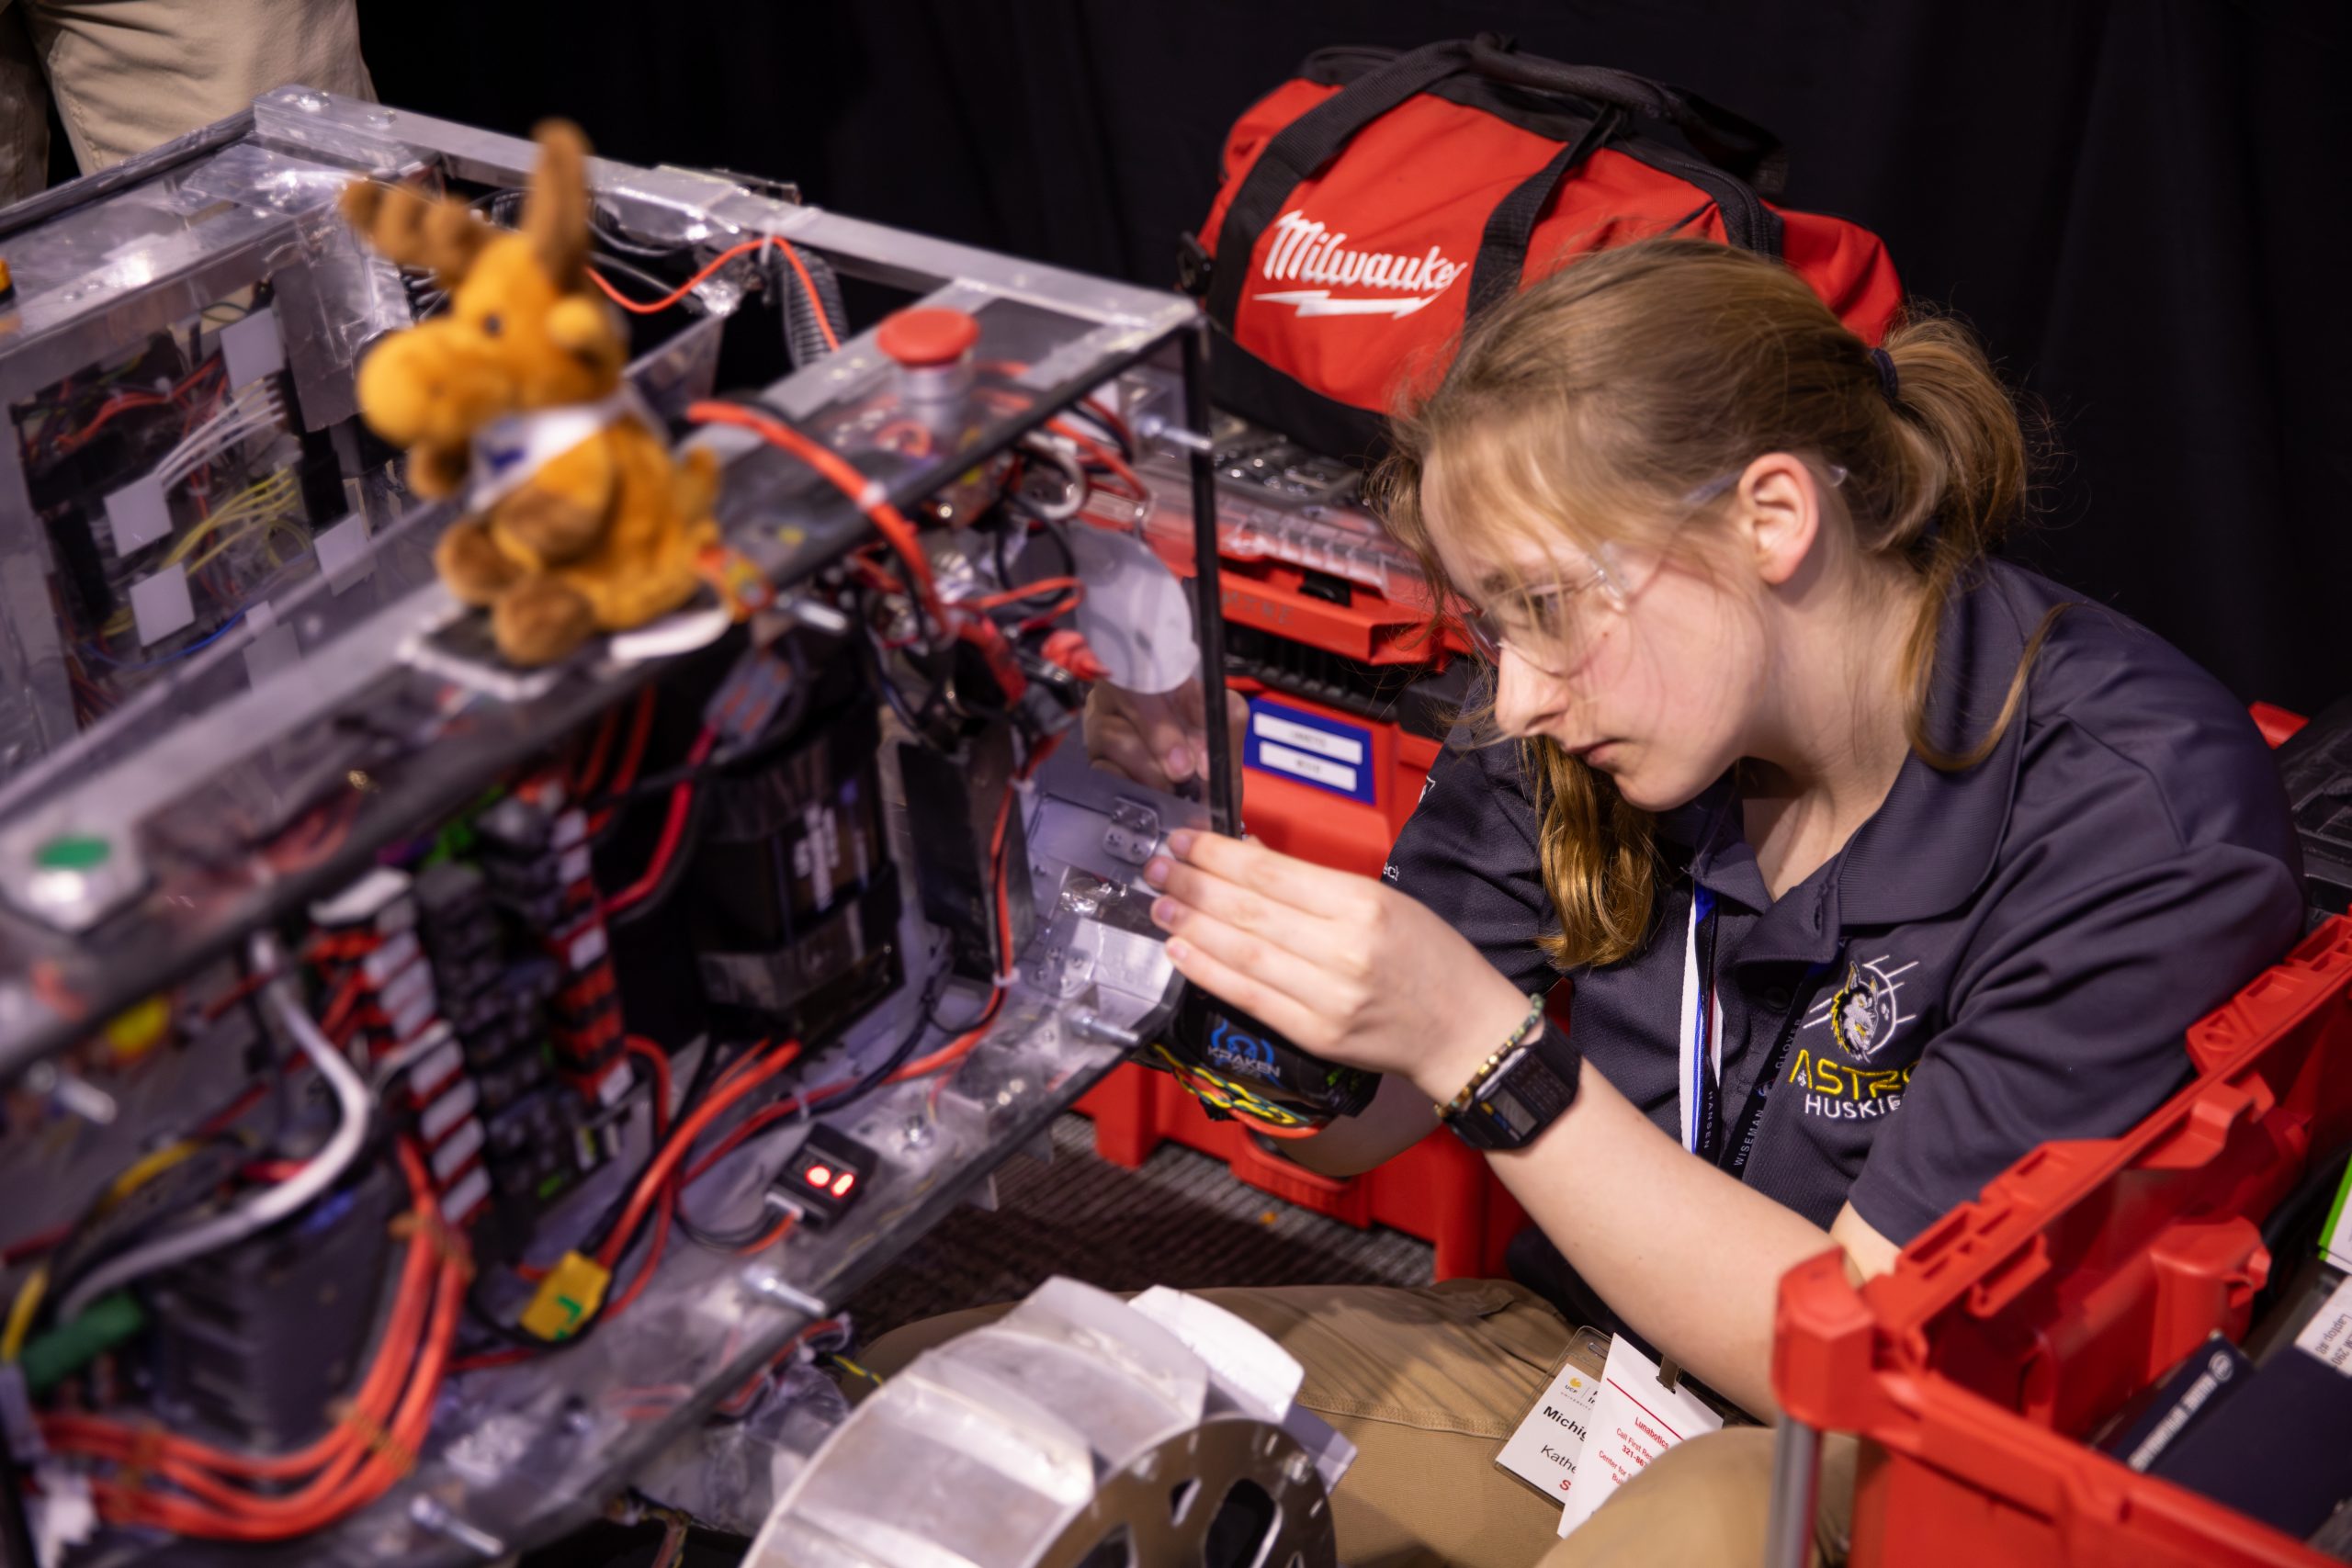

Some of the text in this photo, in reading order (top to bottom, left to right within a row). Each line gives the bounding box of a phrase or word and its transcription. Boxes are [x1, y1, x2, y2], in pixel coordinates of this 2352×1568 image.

[1262, 209, 1468, 291] Milwauke
[1206, 1043, 1282, 1078] KRAKEN
[1703, 1090, 1714, 1150] HANSEN
[1804, 1091, 1906, 1119] HUSKIE
[1734, 1109, 1765, 1167] WISEMAN
[2323, 1314, 2352, 1342] Laptop
[1616, 1427, 1629, 1442] Call
[1627, 1436, 1642, 1453] First
[1634, 1416, 1670, 1450] Lunabotics
[1599, 1449, 1619, 1470] Center
[1618, 1465, 1628, 1477] for
